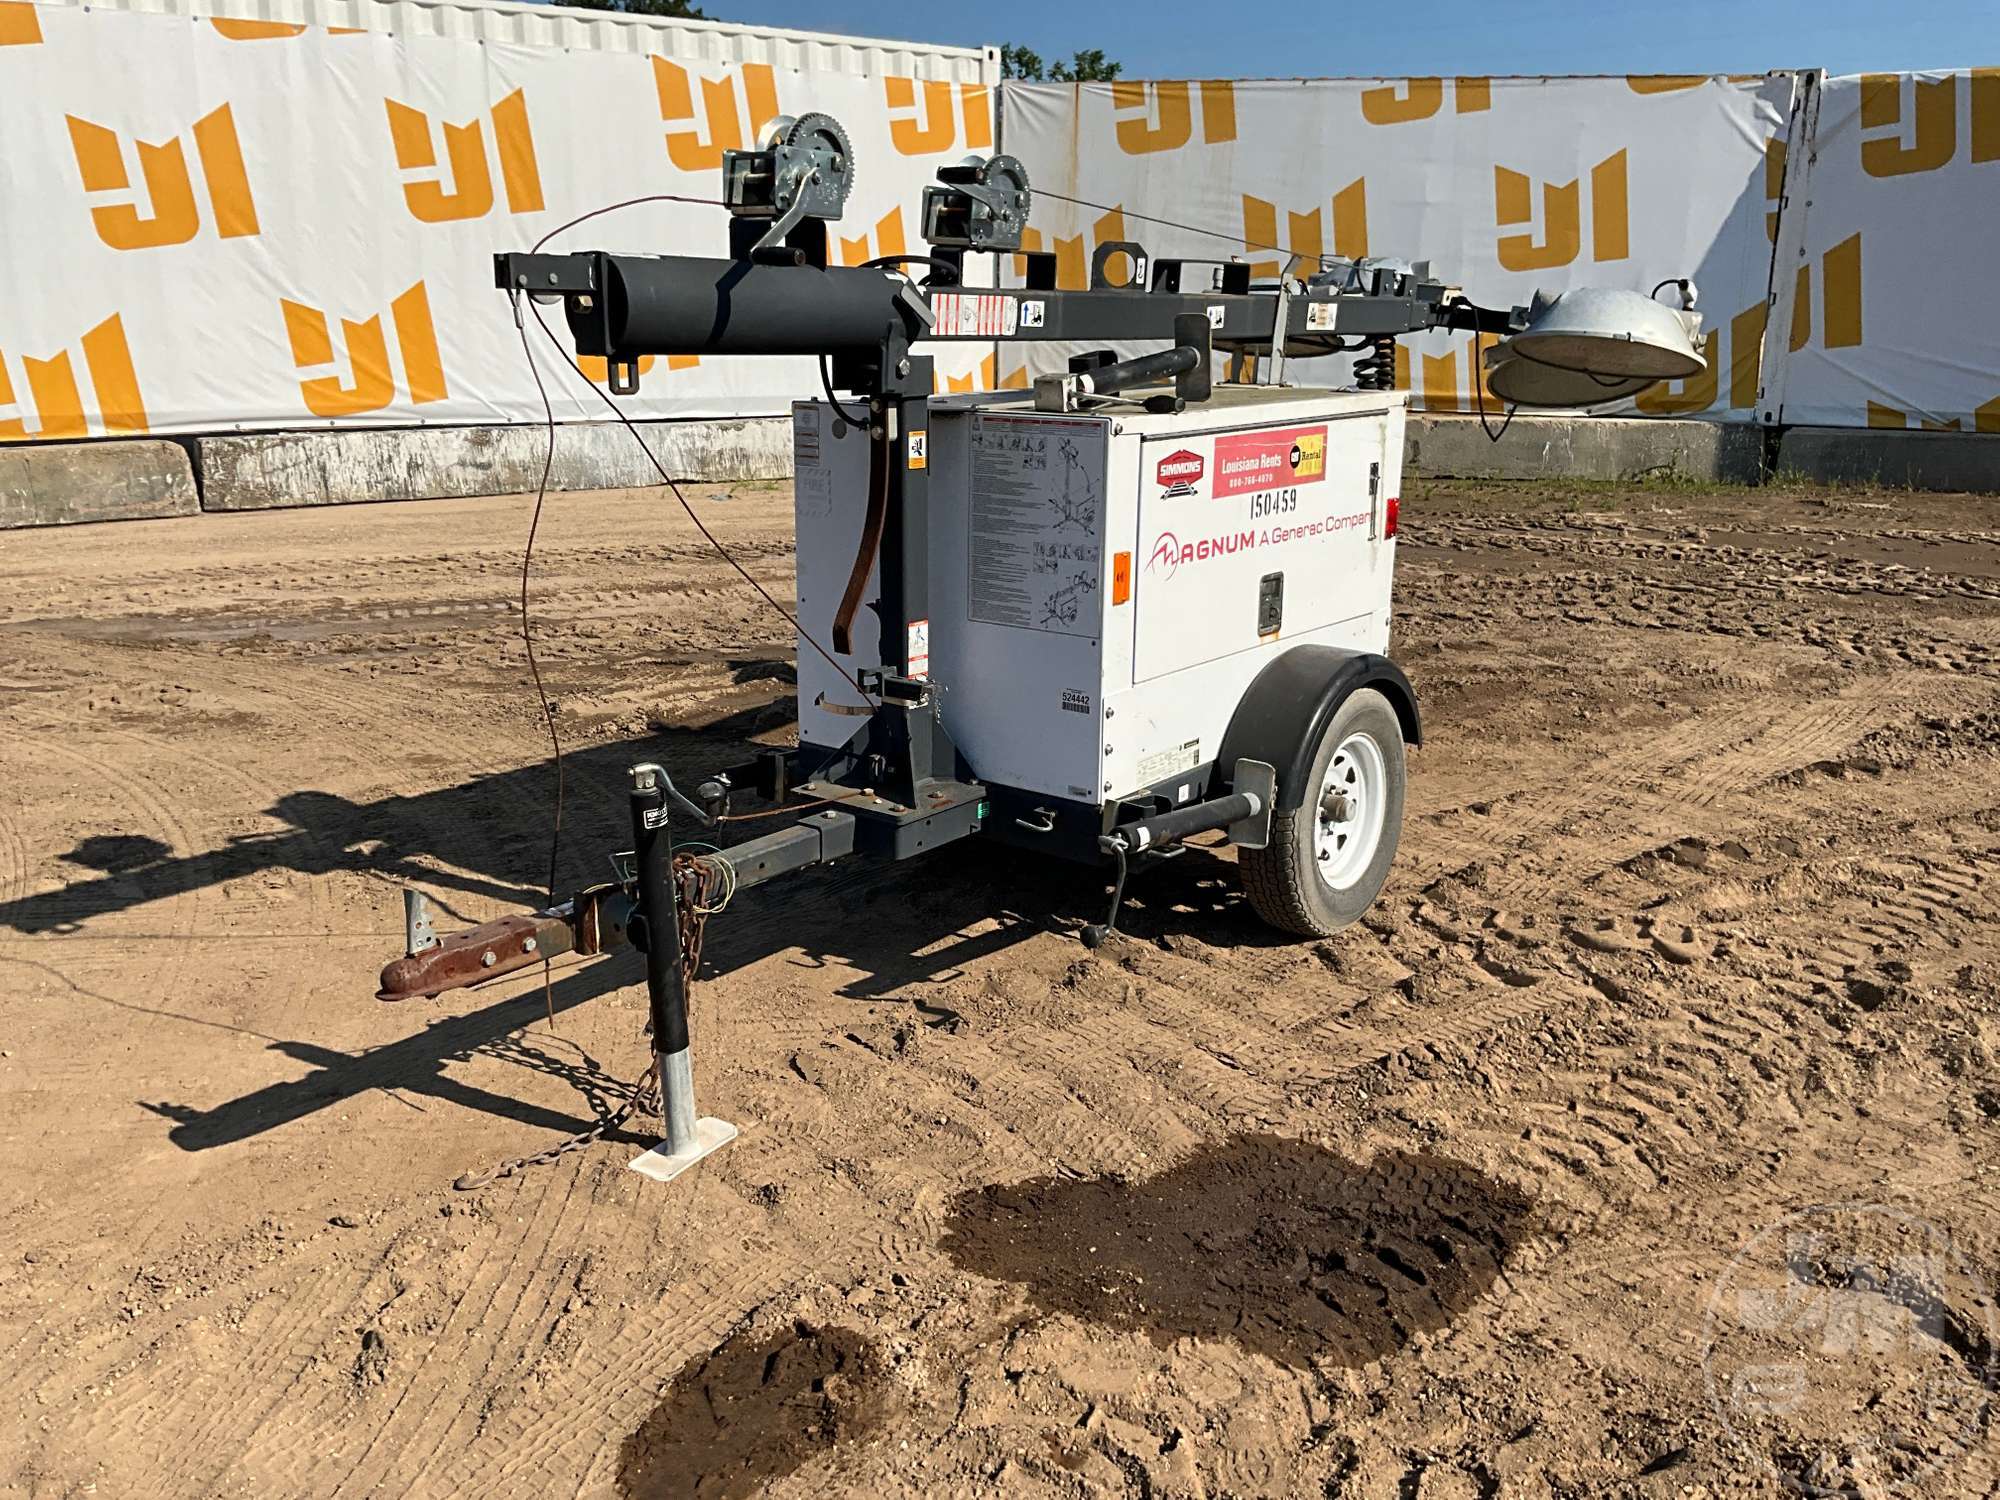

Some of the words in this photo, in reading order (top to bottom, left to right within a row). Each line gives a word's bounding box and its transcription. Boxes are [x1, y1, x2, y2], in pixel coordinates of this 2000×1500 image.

[1160, 461, 1201, 477] SIMMONS
[1222, 456, 1259, 474] Louisiana
[1261, 453, 1281, 468] Rents
[1250, 488, 1297, 520] 150459
[1259, 530, 1270, 547] A
[1271, 523, 1324, 544] Generac
[1062, 692, 1090, 705] 524442
